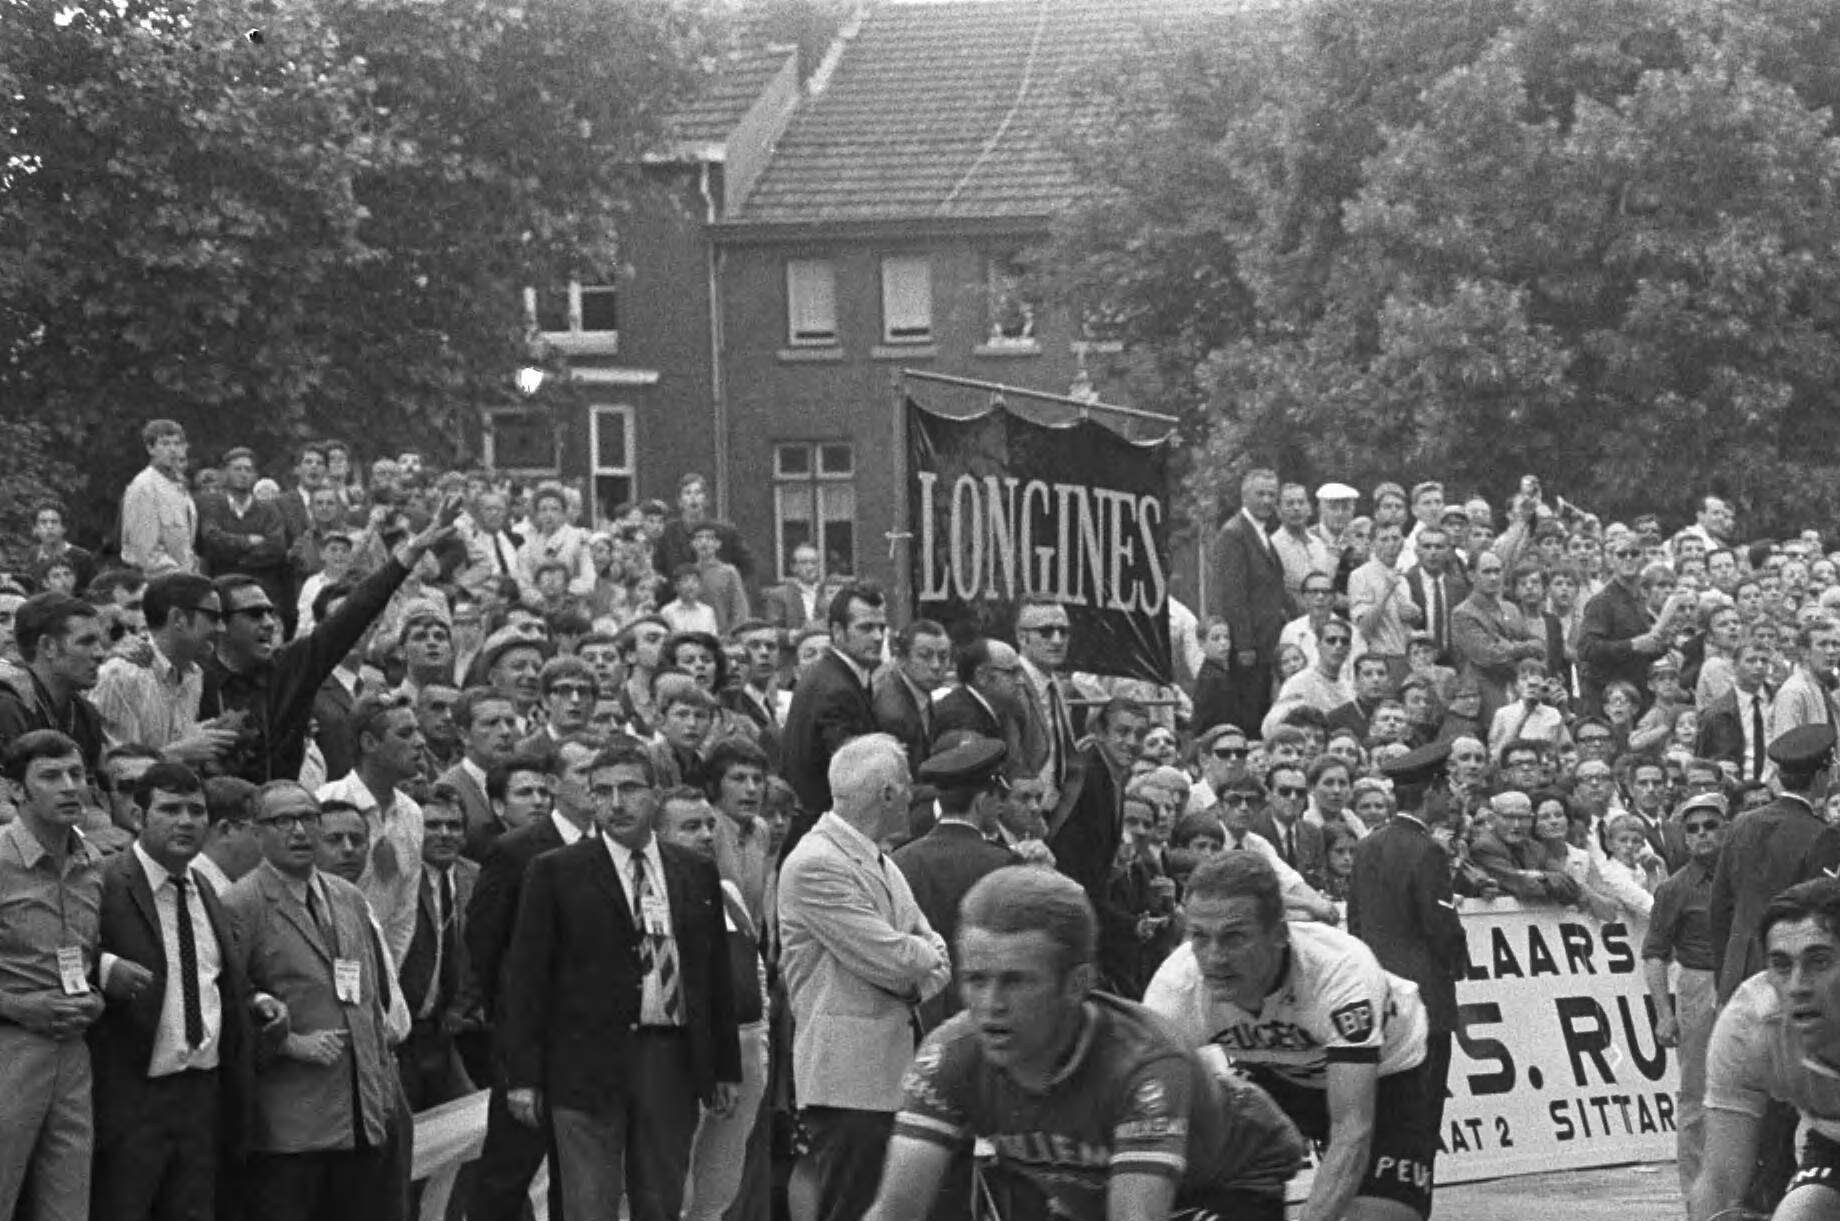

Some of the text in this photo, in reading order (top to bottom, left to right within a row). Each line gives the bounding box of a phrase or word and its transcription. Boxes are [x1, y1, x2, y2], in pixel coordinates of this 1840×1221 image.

[918, 471, 1165, 617] LONGINES
[1438, 1092, 1678, 1154] AT 2 SITTAR
